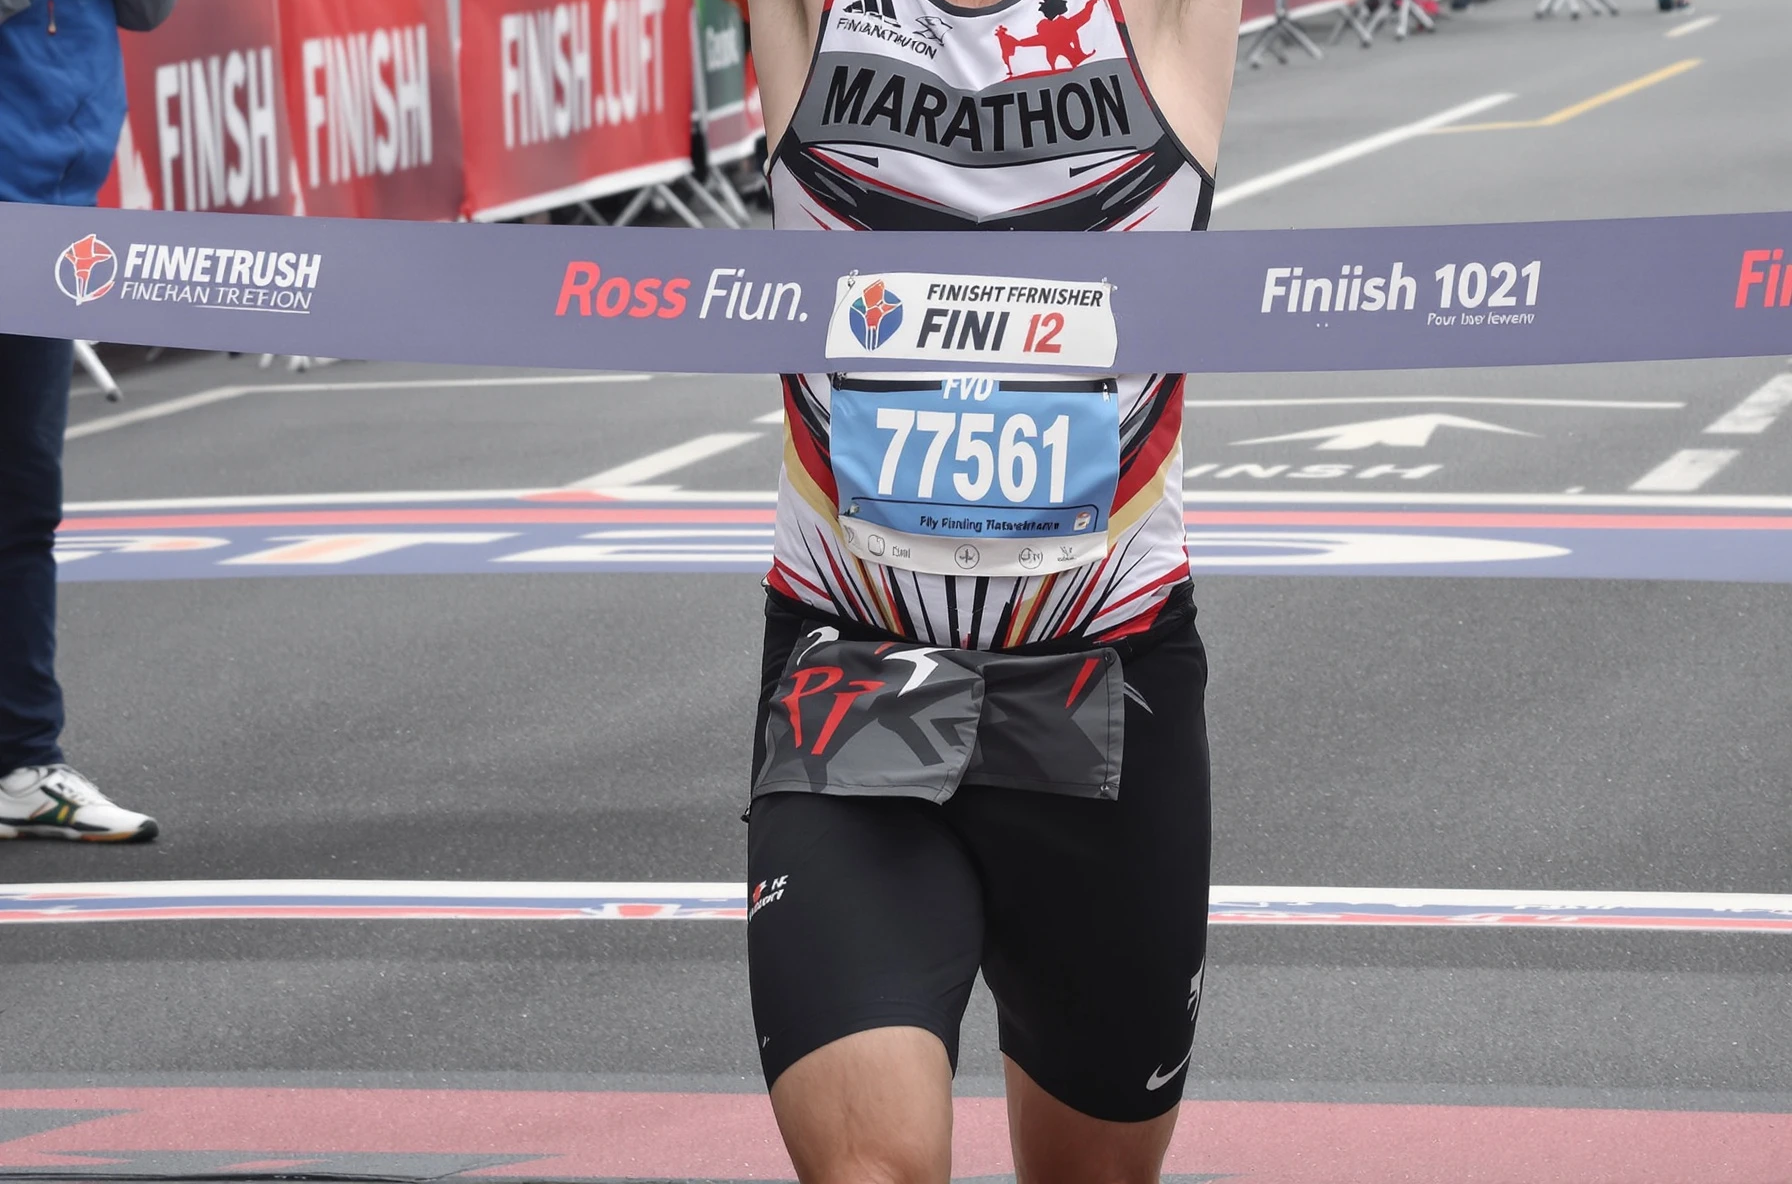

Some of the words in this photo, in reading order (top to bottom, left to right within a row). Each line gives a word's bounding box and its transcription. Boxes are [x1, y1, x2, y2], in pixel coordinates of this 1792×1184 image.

[821, 65, 1131, 153] MARATHON
[555, 260, 692, 319] Ross
[698, 268, 809, 322] Fiun.
[1260, 261, 1418, 314] Finiish
[1434, 260, 1542, 309] 1021
[916, 307, 1011, 352] FINI
[1022, 312, 1065, 354] 12
[876, 407, 1070, 503] 77561
